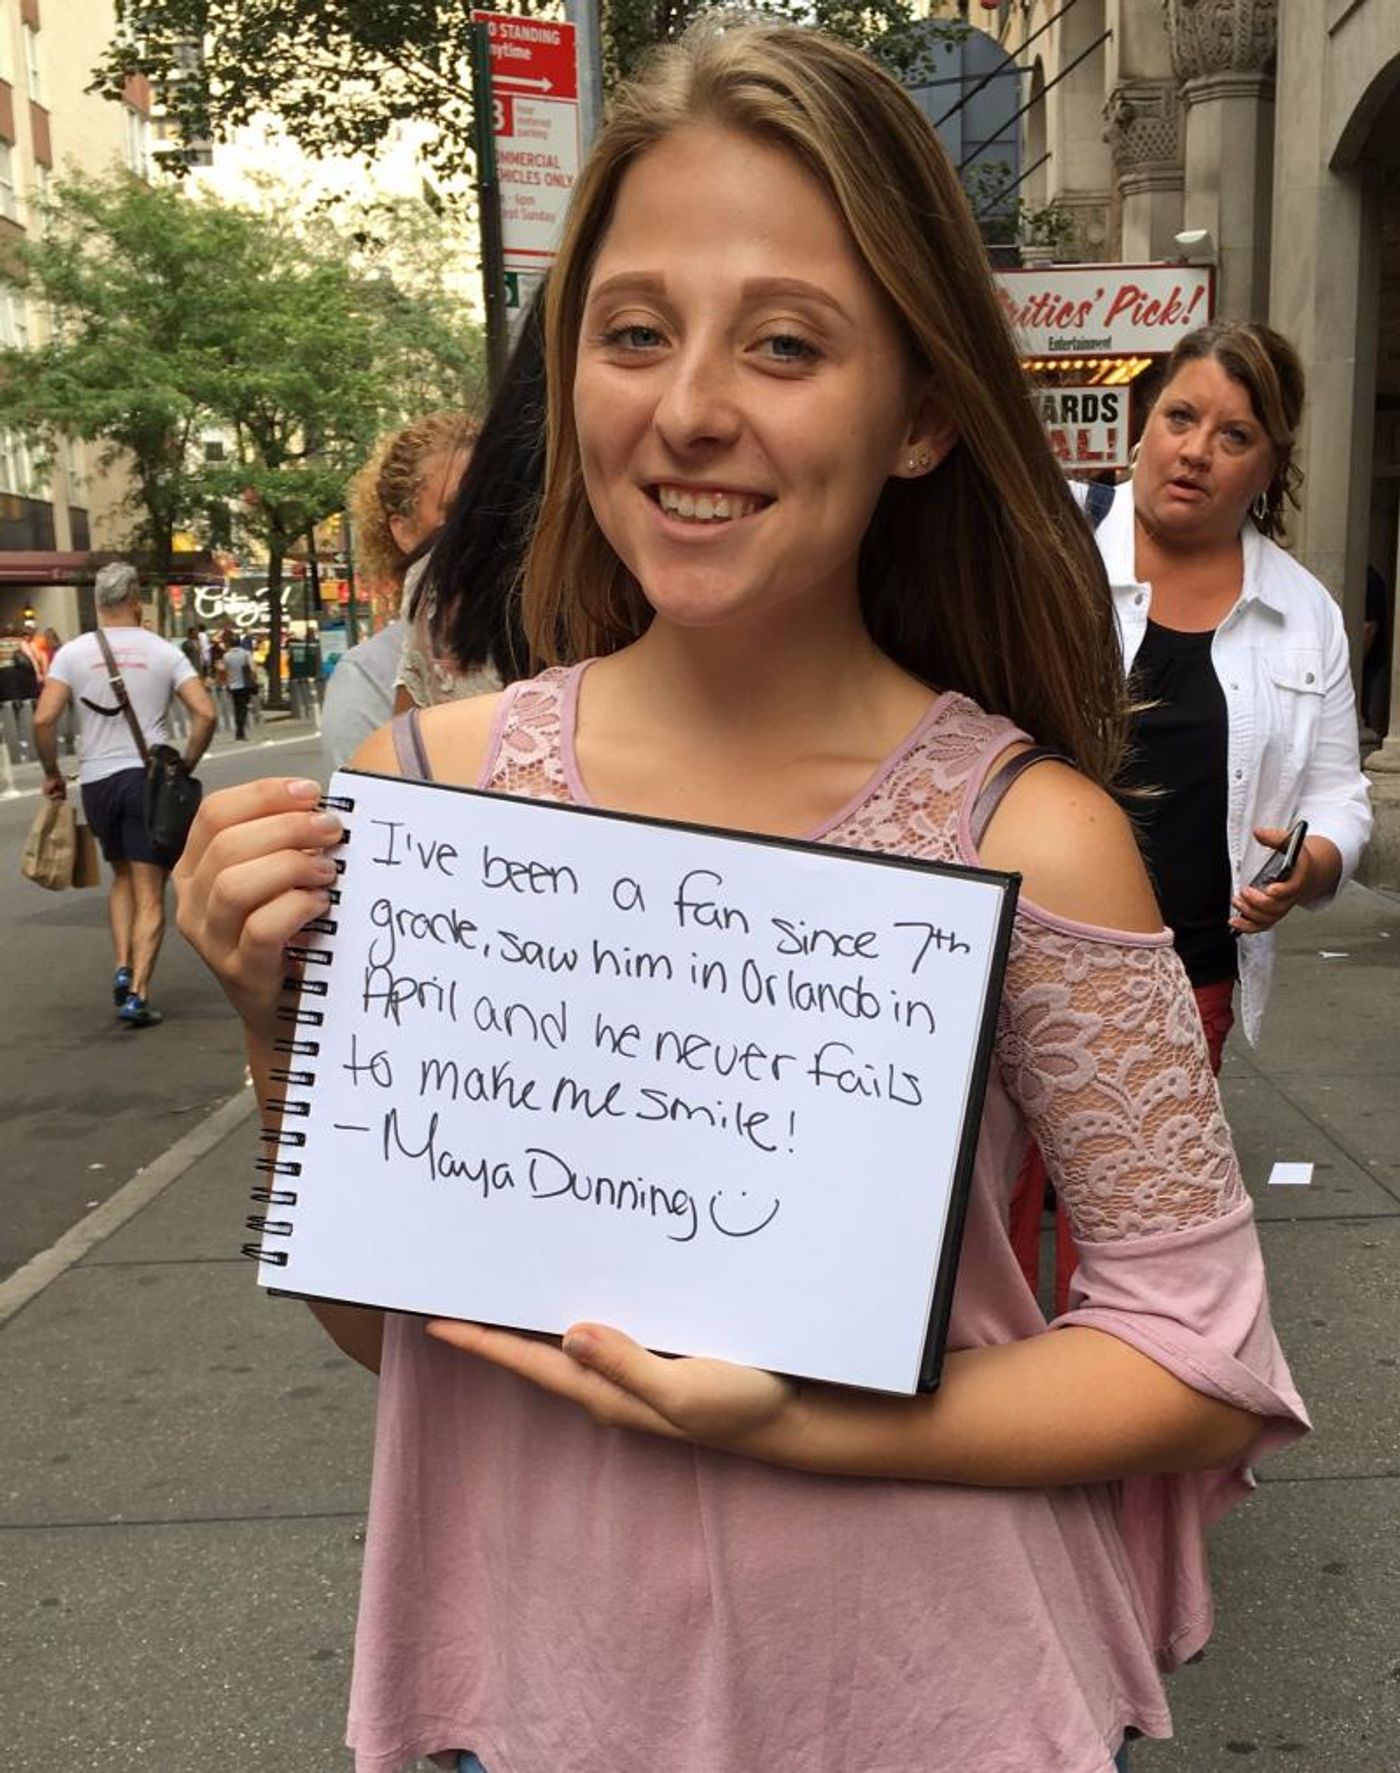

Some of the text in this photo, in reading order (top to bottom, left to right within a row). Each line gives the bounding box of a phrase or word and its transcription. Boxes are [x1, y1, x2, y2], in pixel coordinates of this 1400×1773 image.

[499, 23, 561, 46] STANDING
[496, 168, 574, 189] HICLES ONLY
[497, 149, 561, 169] MMERCIAL
[1102, 284, 1206, 328] Pick!
[371, 819, 971, 974] I've been a fan since 7th
[498, 929, 578, 972] saw
[593, 939, 673, 980] him
[690, 952, 727, 993] in
[742, 958, 880, 1019] Orlando
[890, 989, 936, 1034] in
[363, 966, 923, 1105] April and he never fails
[343, 1033, 795, 1152] to make me smile!
[524, 1148, 699, 1242] Dunning
